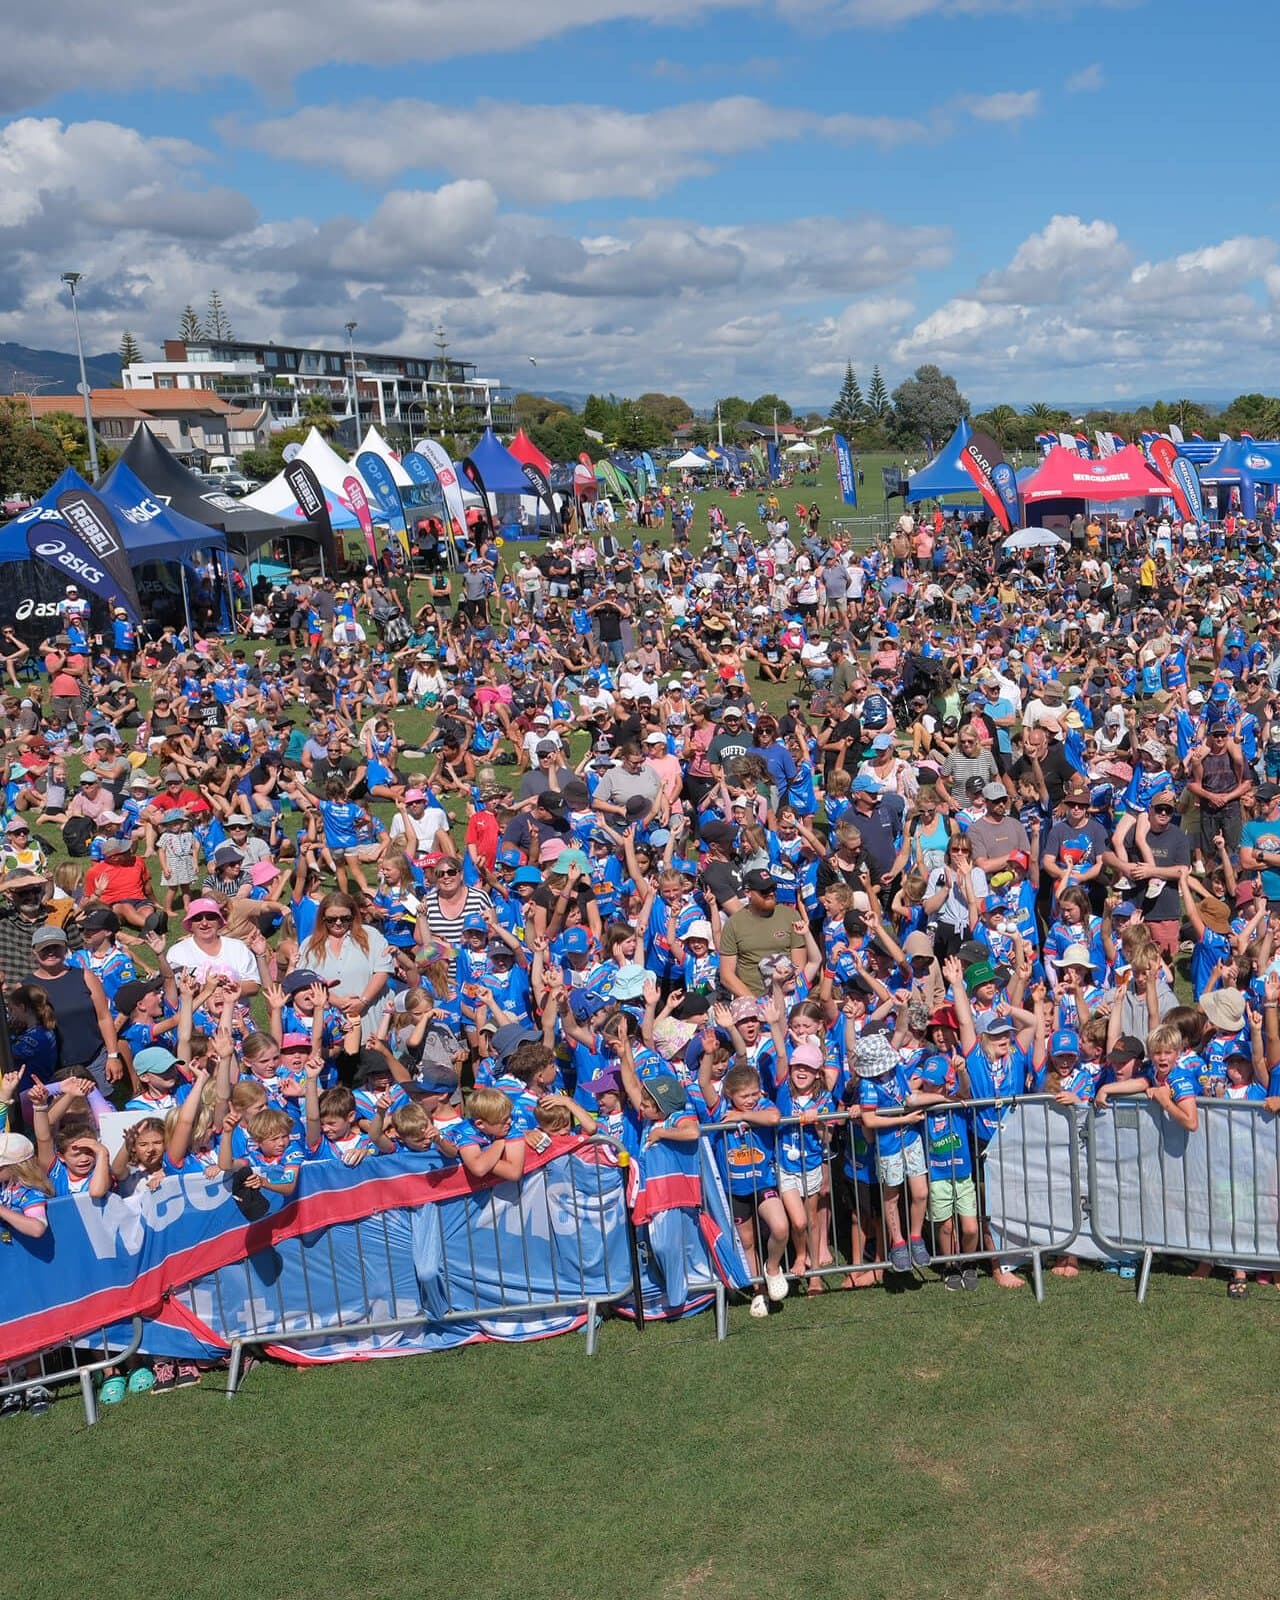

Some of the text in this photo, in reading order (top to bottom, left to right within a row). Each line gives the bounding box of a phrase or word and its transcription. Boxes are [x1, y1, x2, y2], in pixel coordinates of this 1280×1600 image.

[365, 458, 381, 482] TOP
[410, 457, 426, 478] TOP
[1072, 473, 1130, 482] MERCHANDISE
[294, 473, 318, 510] REBEL
[1179, 461, 1199, 511] MERCHANDISE
[70, 506, 110, 553] REBEL
[58, 551, 105, 585] asics
